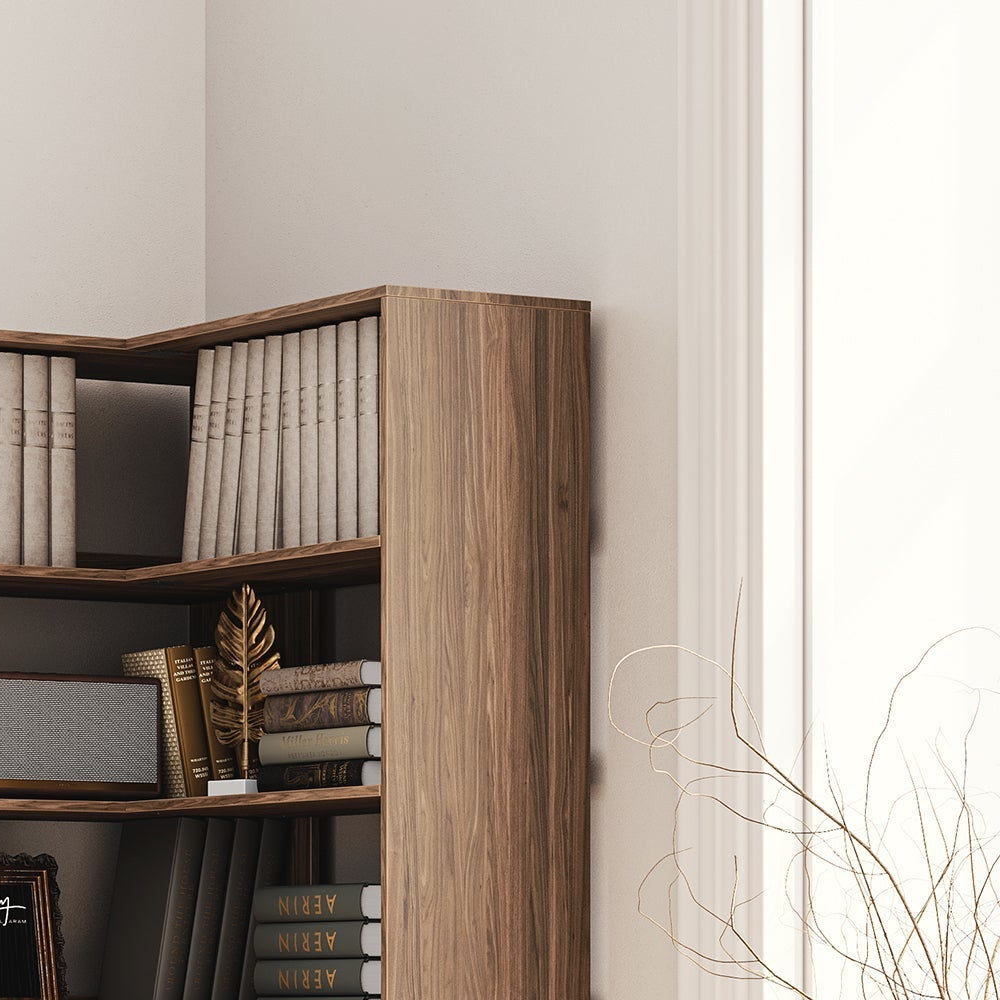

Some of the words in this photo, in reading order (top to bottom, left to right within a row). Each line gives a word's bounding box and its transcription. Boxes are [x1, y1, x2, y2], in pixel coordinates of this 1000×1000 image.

[278, 895, 337, 915] AERIN
[278, 932, 337, 952] AERIN
[278, 969, 337, 990] AERIN
